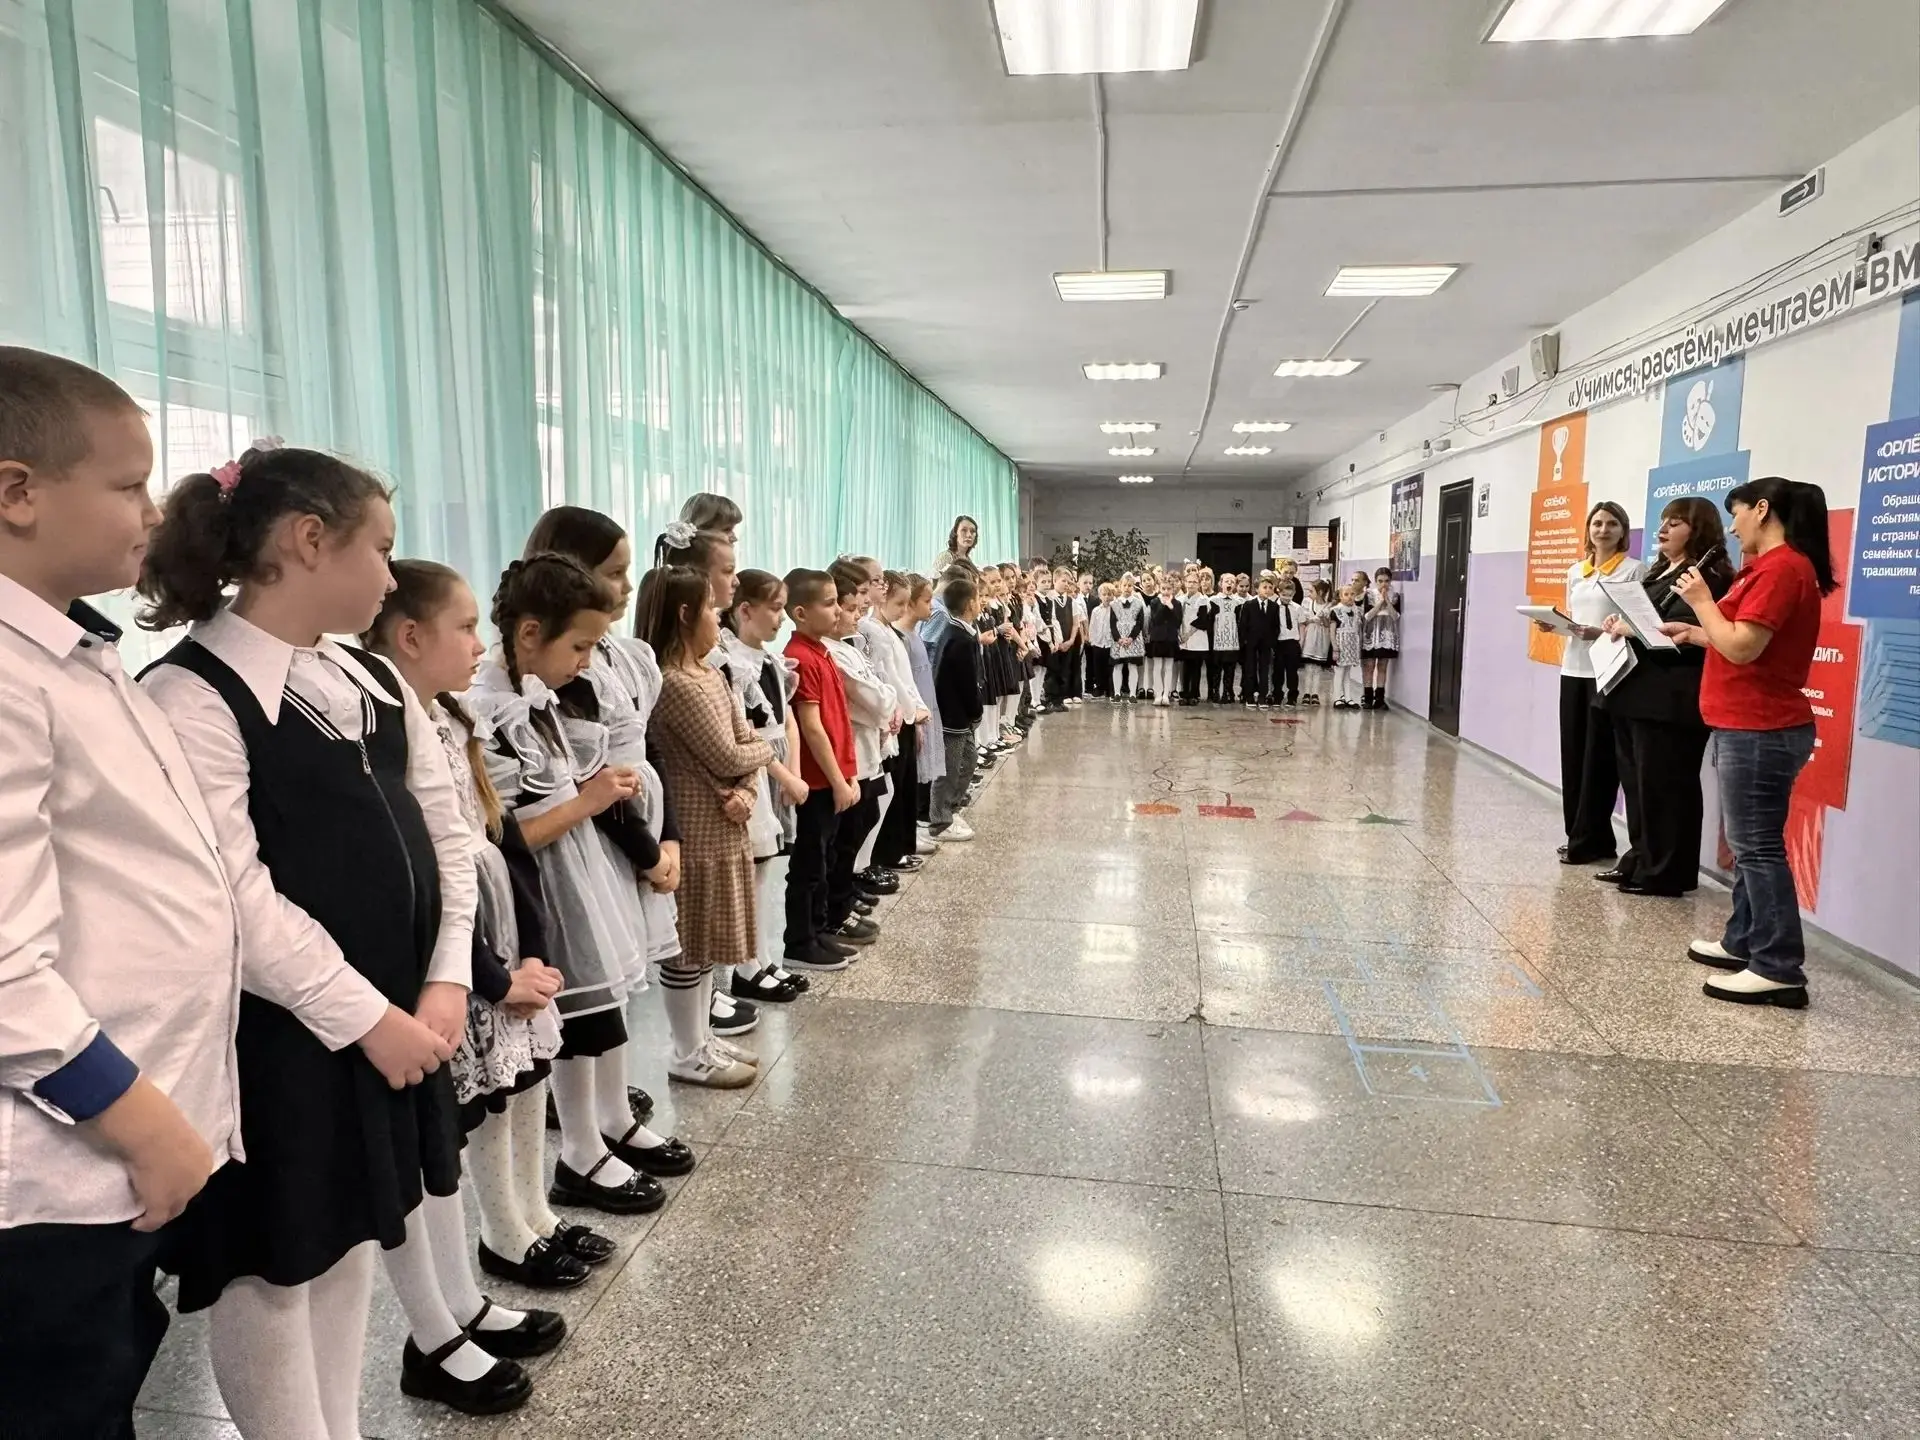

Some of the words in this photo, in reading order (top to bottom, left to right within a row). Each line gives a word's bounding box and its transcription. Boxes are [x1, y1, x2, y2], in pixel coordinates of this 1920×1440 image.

[1568, 363, 1637, 407] «Учимся,
[1641, 328, 1719, 390] растём,
[1726, 270, 1852, 351] мечтаем
[1862, 546, 1913, 560] семейных
